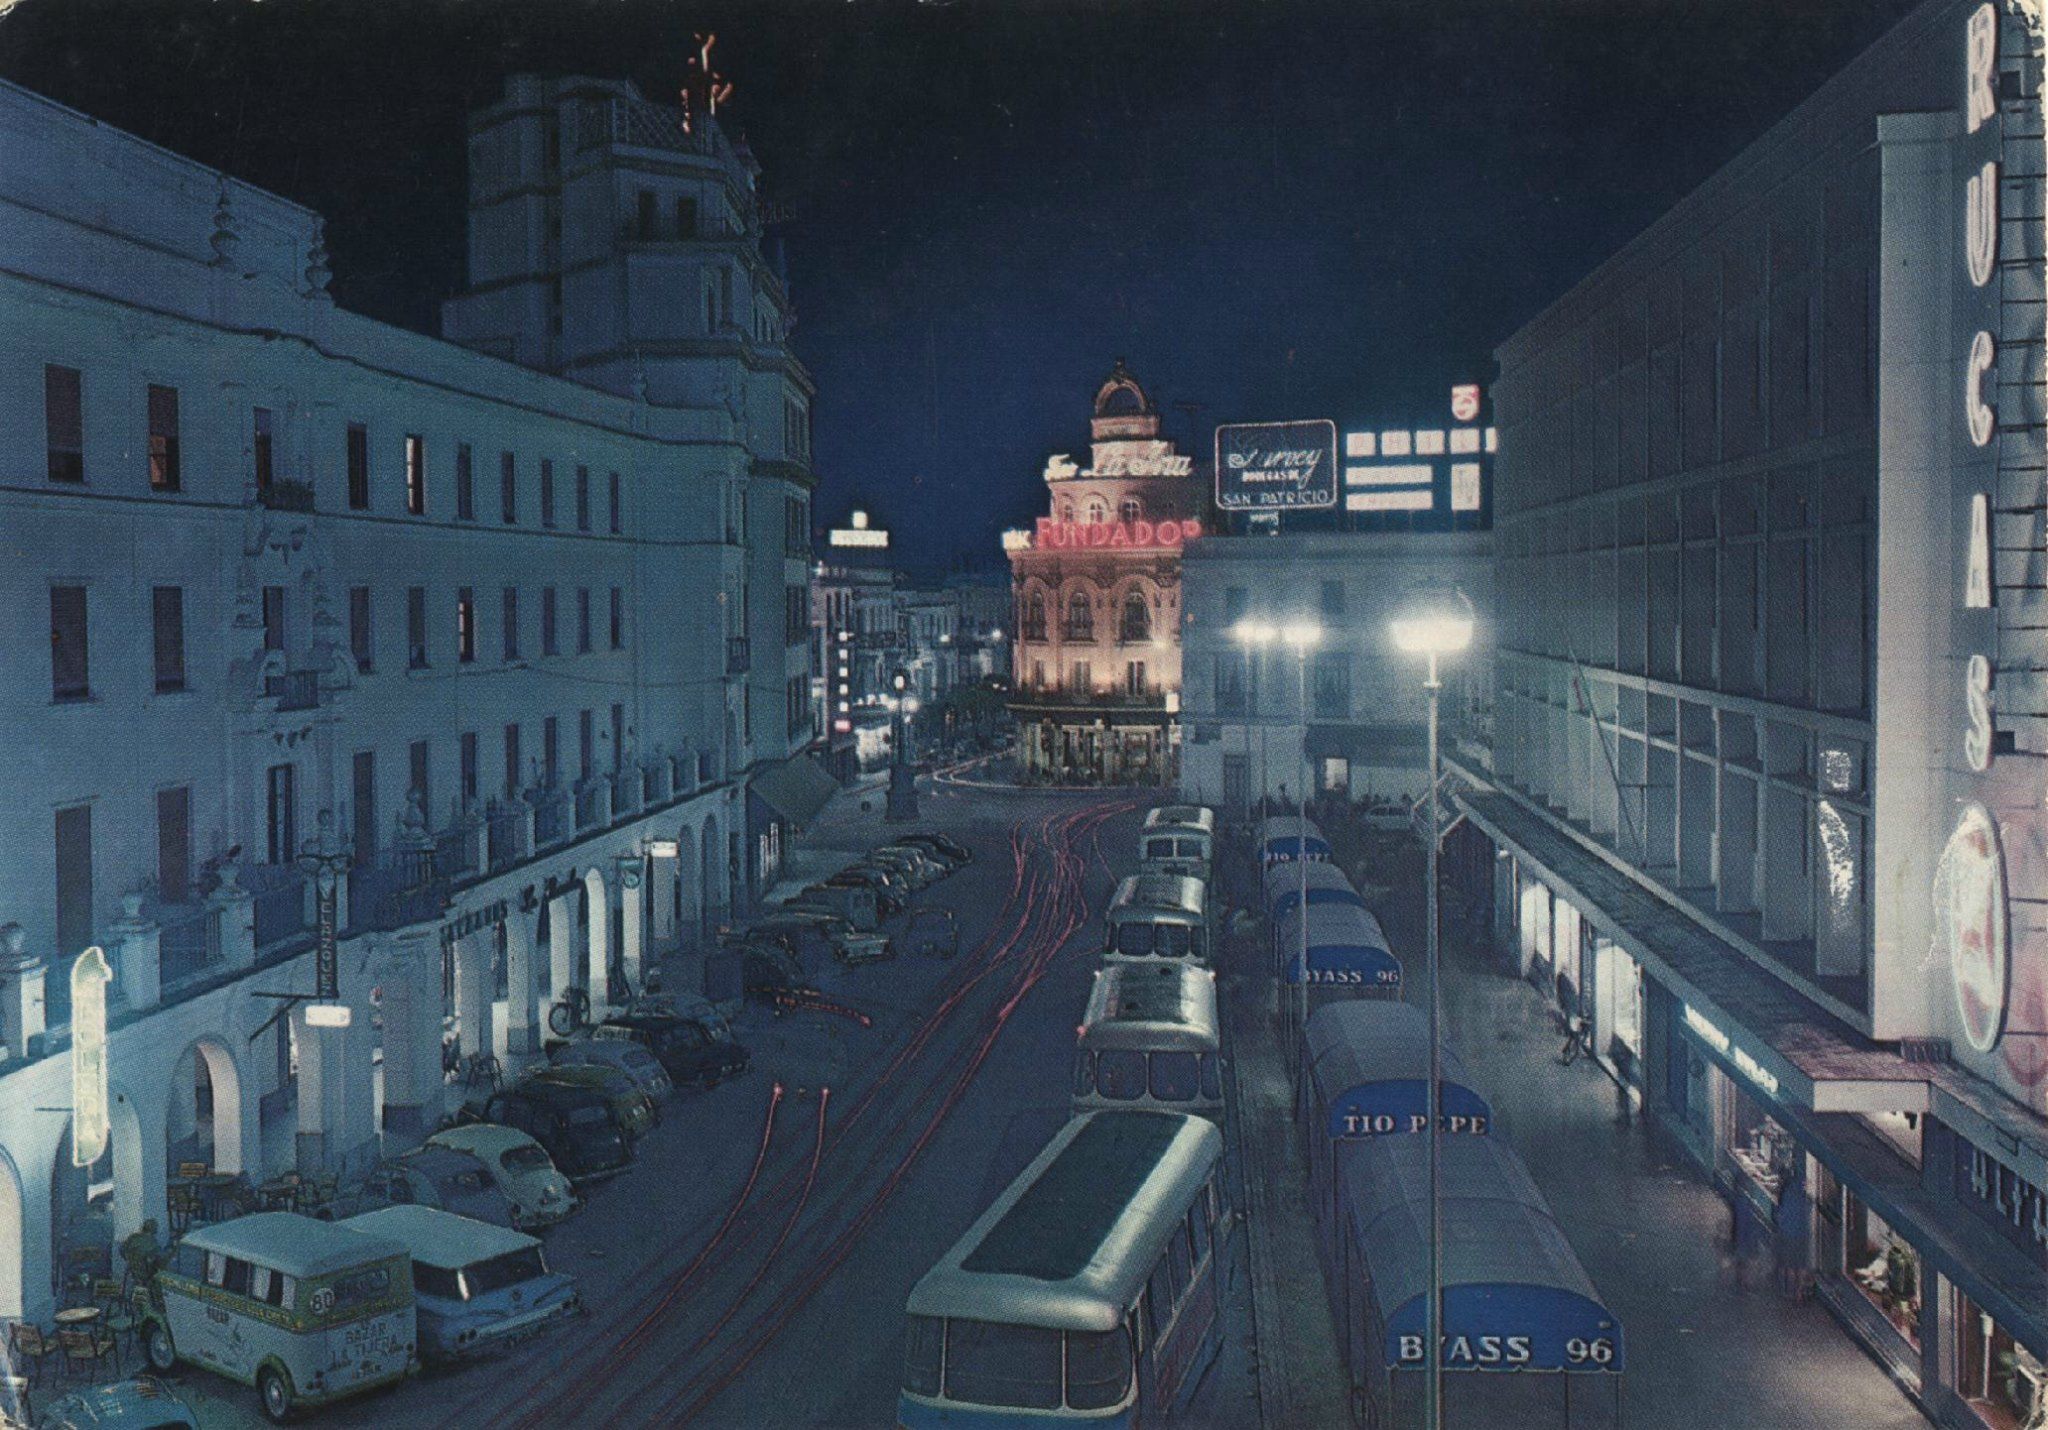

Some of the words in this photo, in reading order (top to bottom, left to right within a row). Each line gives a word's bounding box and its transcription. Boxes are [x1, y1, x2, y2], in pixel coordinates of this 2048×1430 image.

[1223, 493, 1251, 505] SAN
[1261, 489, 1328, 503] PATRICIO
[1377, 970, 1398, 984] 96
[1344, 1113, 1395, 1134] TIO
[313, 1291, 334, 1312] 80
[1400, 1335, 1531, 1362] BASS
[1566, 1338, 1613, 1363] 96
